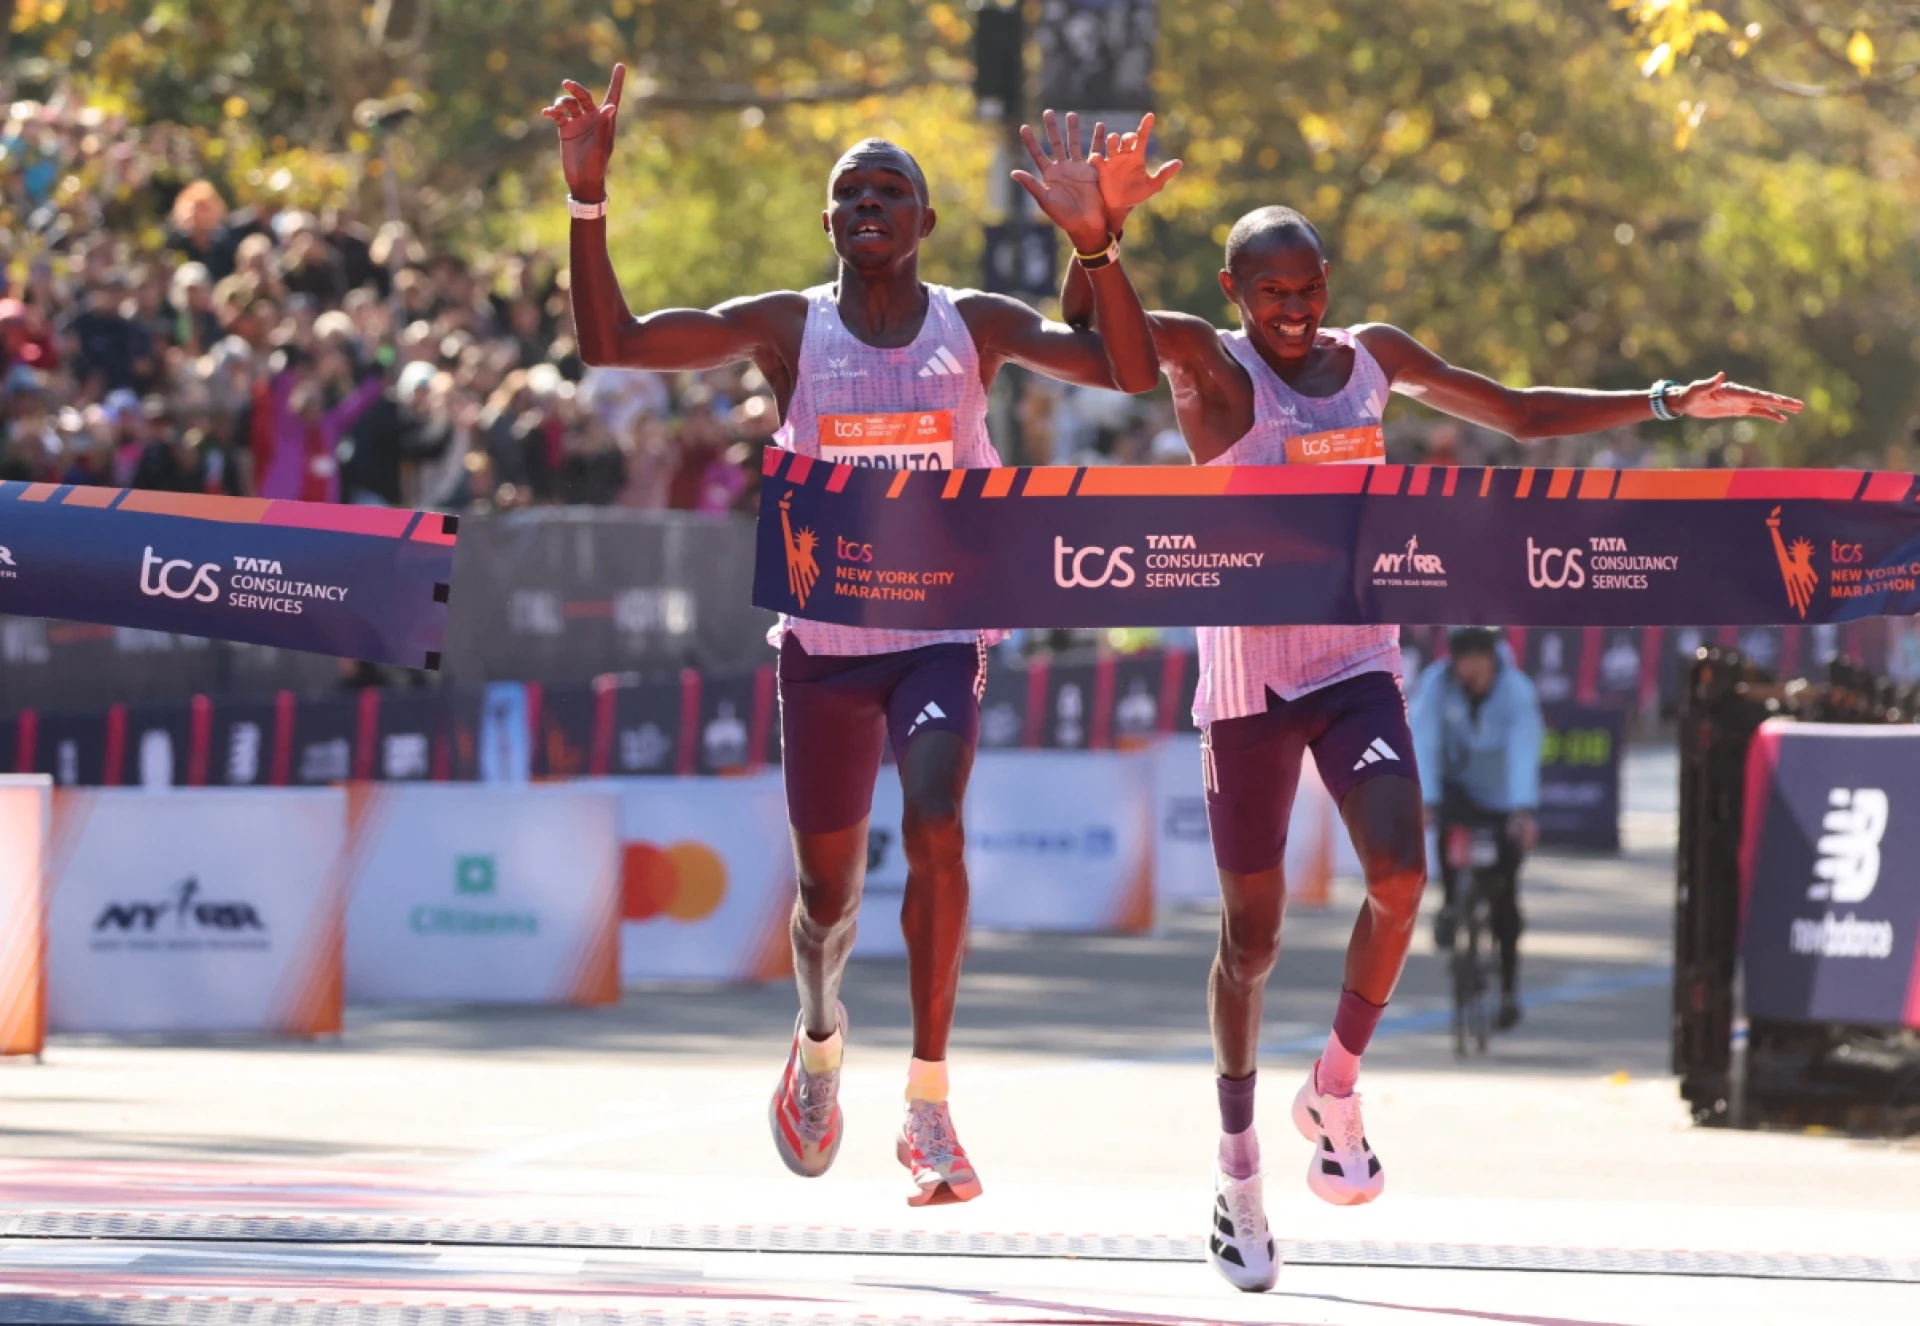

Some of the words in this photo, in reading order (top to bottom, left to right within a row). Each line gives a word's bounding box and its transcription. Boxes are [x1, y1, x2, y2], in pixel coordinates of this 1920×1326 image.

[834, 419, 863, 438] tcs
[917, 427, 938, 435] TATA
[1302, 438, 1330, 456] tcs
[836, 535, 874, 563] tcs
[1145, 534, 1197, 550] TATA
[1589, 536, 1628, 552] TATA
[1831, 539, 1864, 563] tcs
[233, 556, 283, 575] TATA
[1054, 535, 1135, 588] tcs
[1145, 552, 1265, 568] CONSULTANCY
[1527, 536, 1586, 589] tcs
[1590, 556, 1679, 571] CONSULTANCY
[140, 545, 221, 603] tcs
[836, 565, 872, 583] NEW
[876, 570, 919, 585] YORK
[922, 571, 955, 586] CITY
[1145, 571, 1221, 588] SERVICES
[1591, 574, 1649, 590] SERVICES
[1831, 568, 1863, 583] NEW
[1865, 564, 1908, 581] YORK
[231, 574, 349, 602] CONSULTANCY
[834, 582, 926, 602] MARATHON
[1830, 578, 1916, 599] MARATHON
[228, 592, 303, 615] SERVICES
